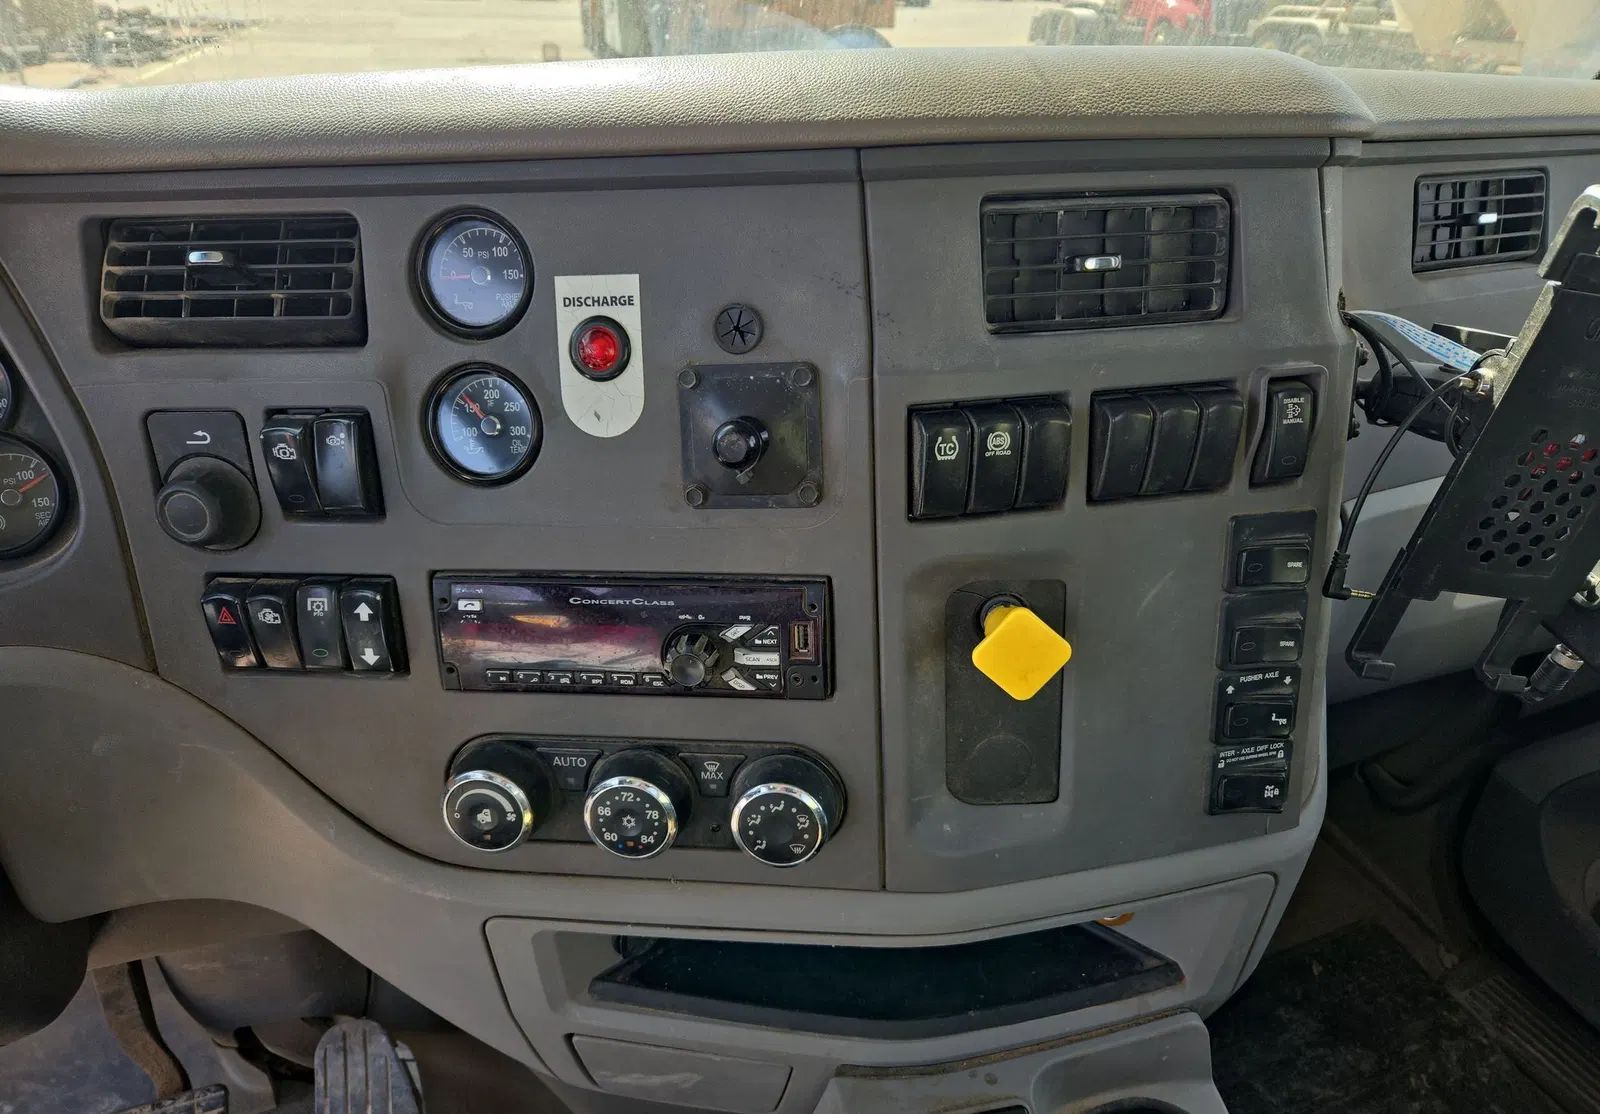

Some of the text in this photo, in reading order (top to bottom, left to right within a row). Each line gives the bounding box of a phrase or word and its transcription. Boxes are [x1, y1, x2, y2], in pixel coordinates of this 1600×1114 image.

[463, 247, 474, 258] 50
[477, 250, 490, 258] PSI
[492, 247, 508, 257] 100
[502, 270, 519, 280] 150
[562, 295, 634, 308] DISCHARGE
[484, 389, 500, 400] 200
[504, 402, 520, 412] 250
[462, 427, 478, 437] 100
[510, 426, 526, 436] 300
[992, 436, 1005, 446] ABS
[939, 443, 954, 456] TC
[16, 470, 34, 480] 100
[32, 496, 50, 508] 150
[34, 512, 51, 520] SEC
[1240, 670, 1280, 683] PUSHER AXLE
[1220, 750, 1236, 758] INTER
[553, 756, 587, 767] AUTO
[701, 772, 724, 780] MAX
[620, 792, 634, 802] 72
[597, 806, 612, 816] 66
[645, 810, 659, 820] 78
[604, 832, 618, 842] 60
[640, 835, 655, 844] 84
